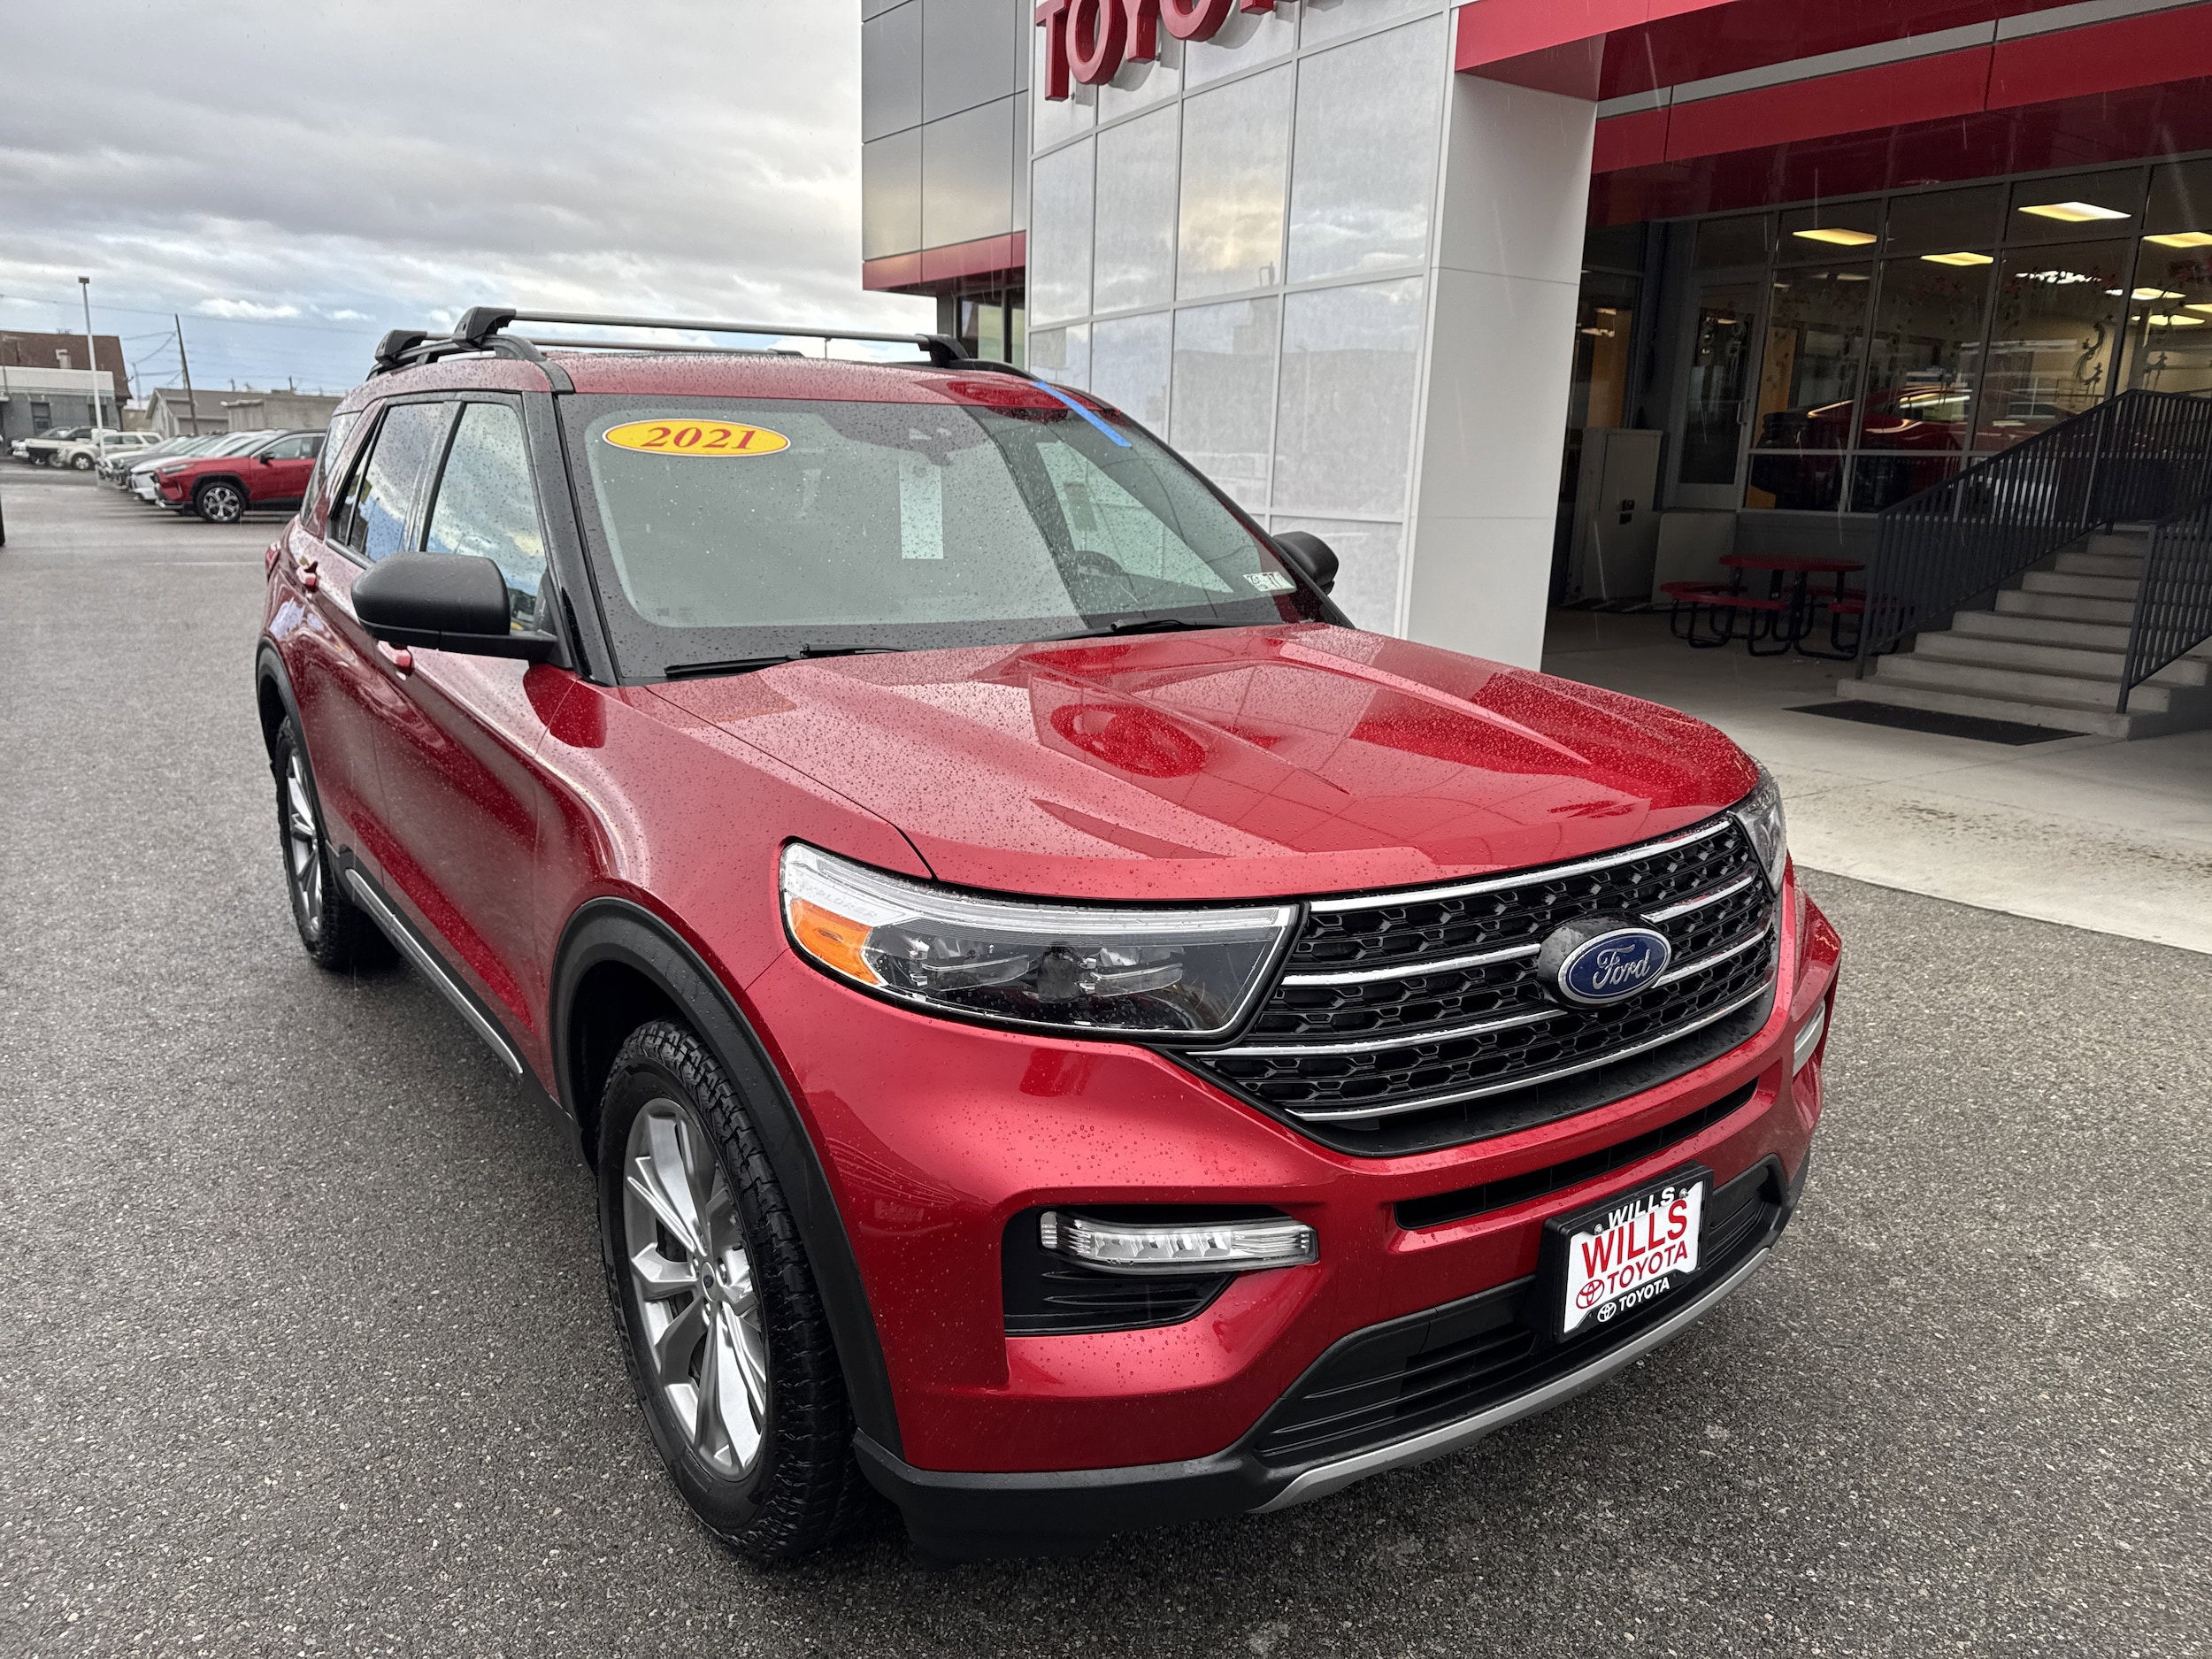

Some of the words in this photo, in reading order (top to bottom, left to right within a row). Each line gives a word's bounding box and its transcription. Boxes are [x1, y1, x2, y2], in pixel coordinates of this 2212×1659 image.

[640, 426, 756, 449] 2021
[1593, 943, 1651, 990] Ford
[1609, 1187, 1675, 1229] WILLS
[1581, 1200, 1687, 1279] WILLS
[1608, 1240, 1688, 1294] TOYOTA
[1618, 1277, 1671, 1311] TOYOTA
